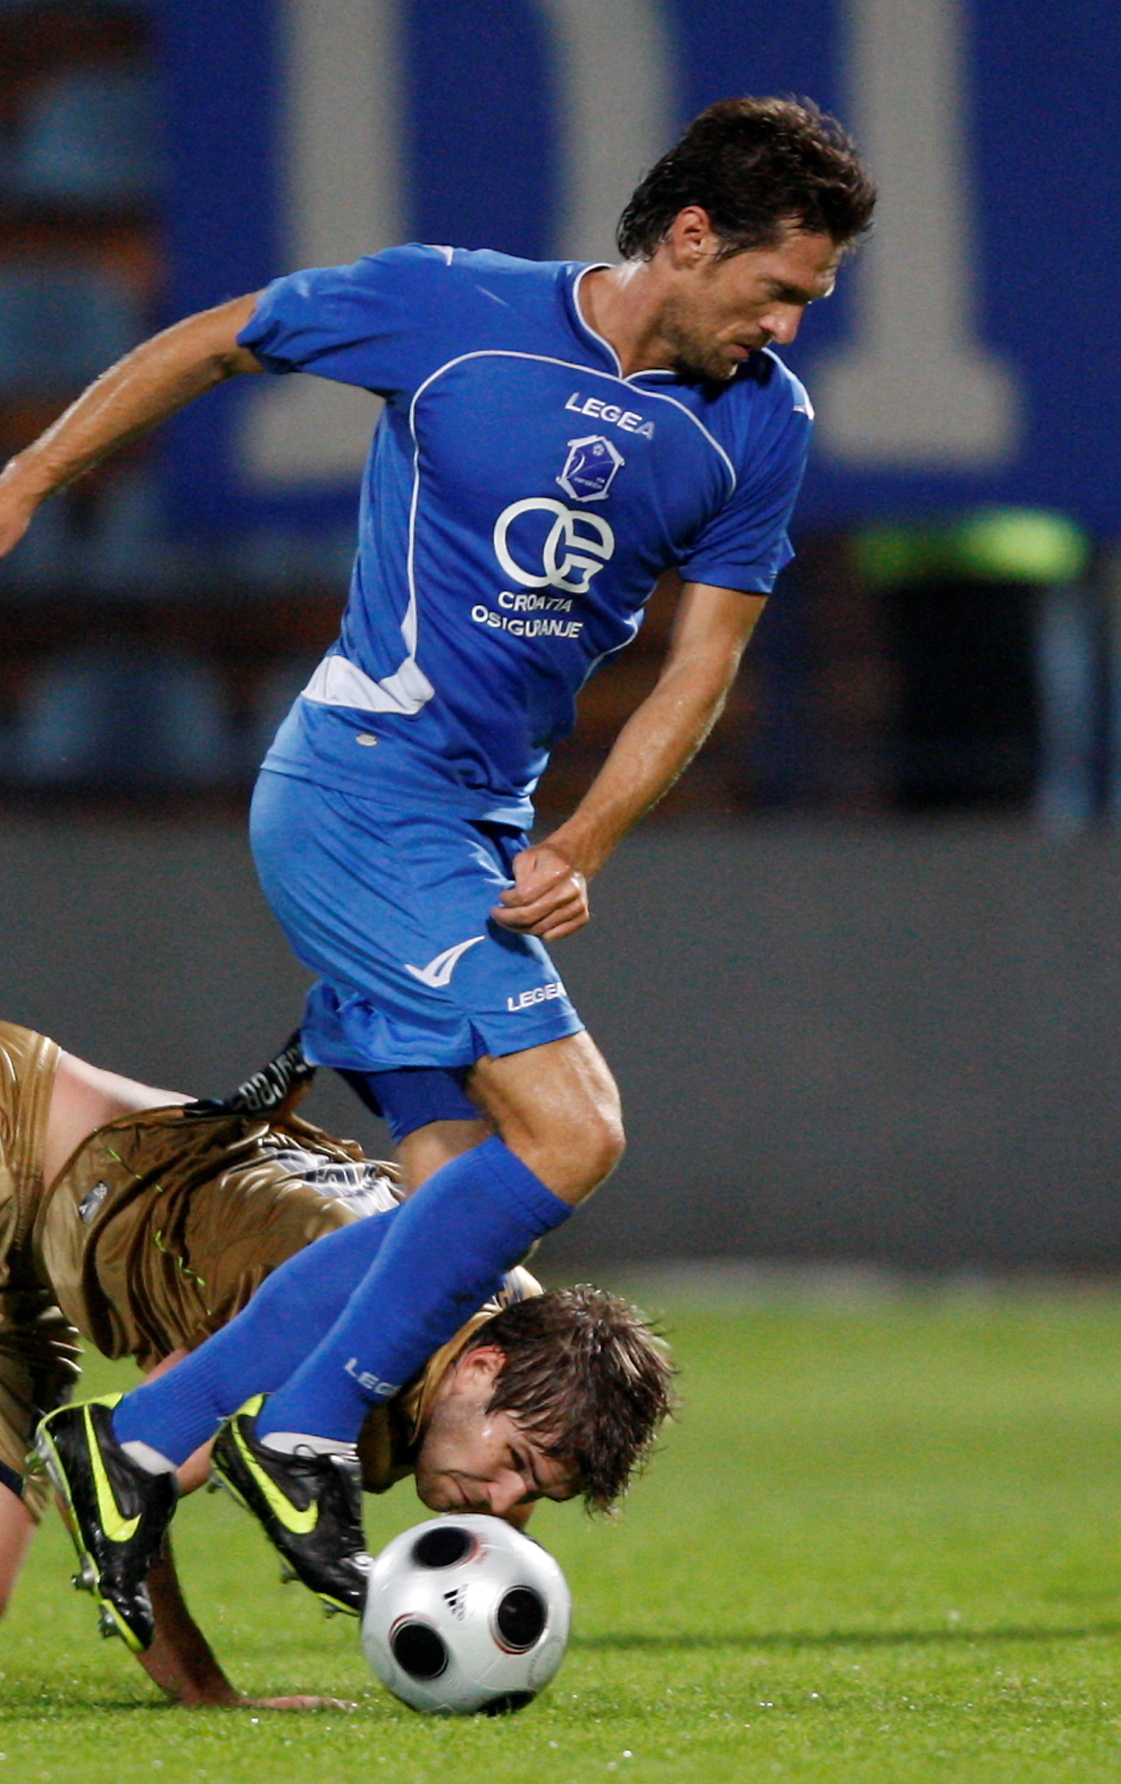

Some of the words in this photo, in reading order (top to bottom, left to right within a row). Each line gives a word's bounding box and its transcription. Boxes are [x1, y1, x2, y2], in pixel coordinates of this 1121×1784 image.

[564, 392, 656, 440] LEGEA
[498, 591, 574, 612] CROATIA
[471, 604, 584, 638] OSIGURANJE
[343, 1357, 403, 1396] LEG
